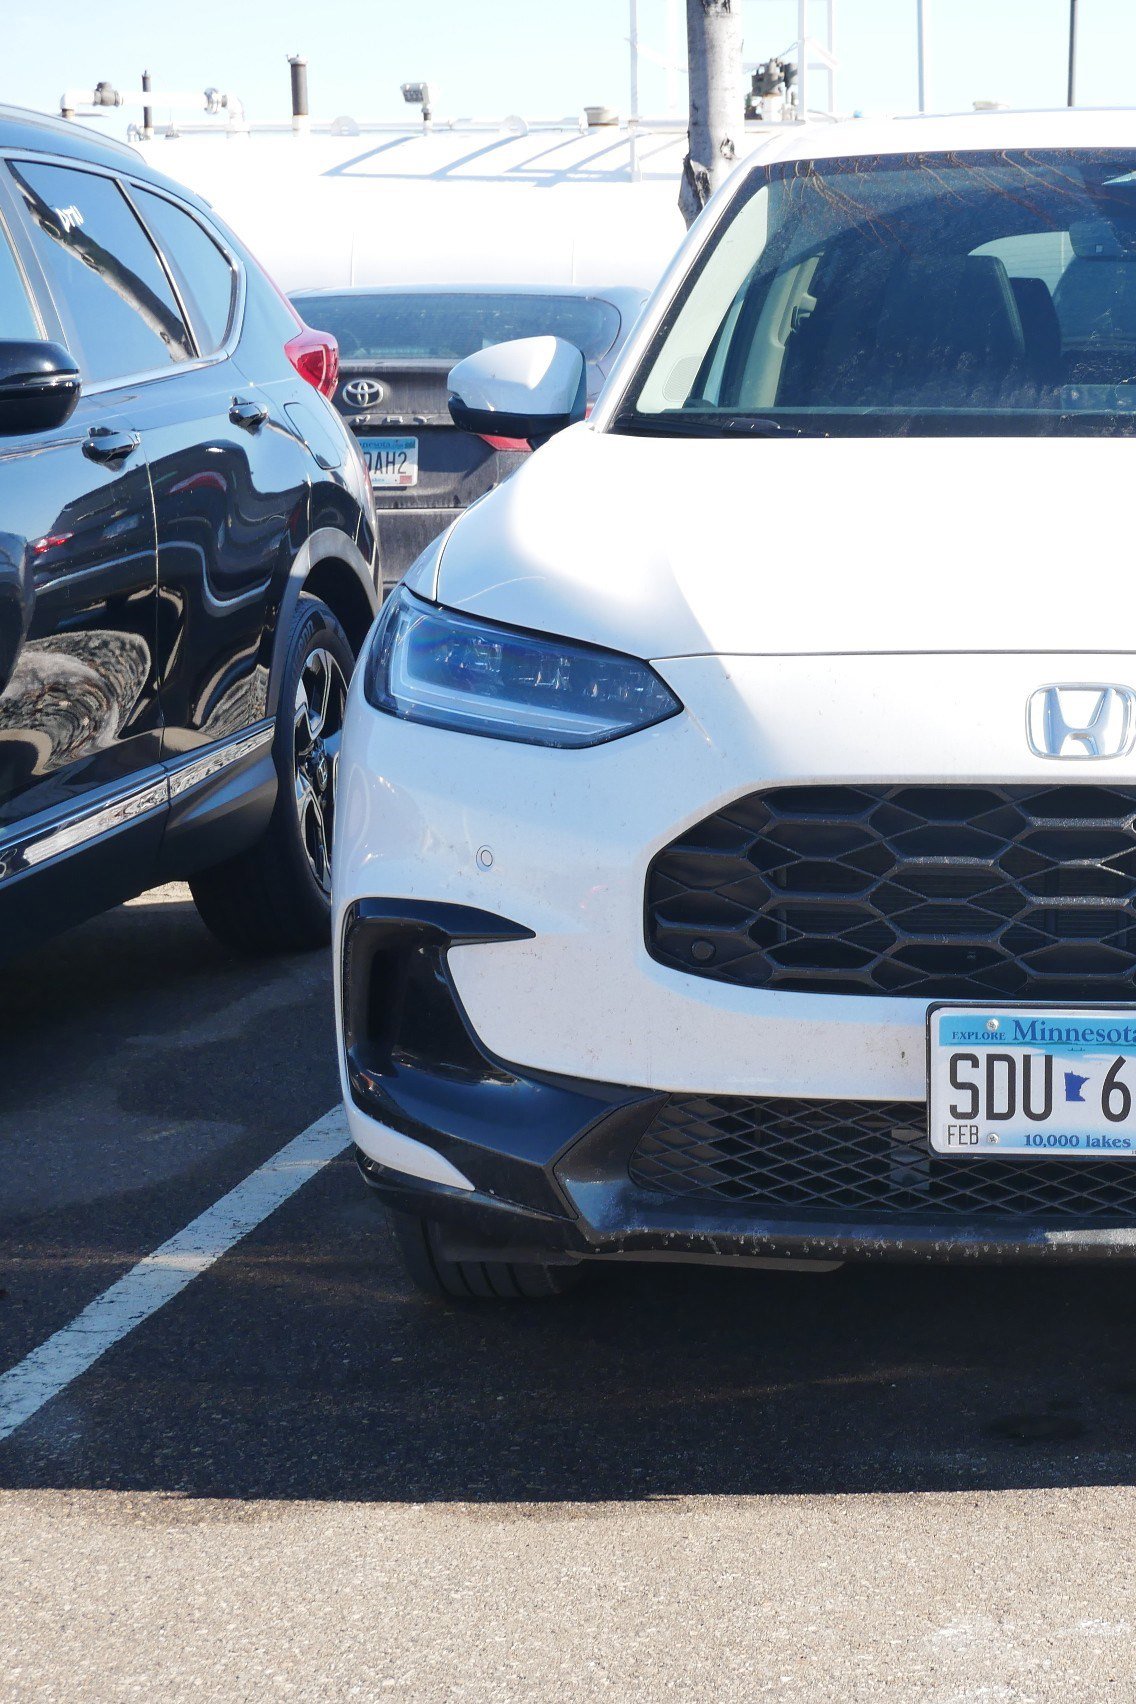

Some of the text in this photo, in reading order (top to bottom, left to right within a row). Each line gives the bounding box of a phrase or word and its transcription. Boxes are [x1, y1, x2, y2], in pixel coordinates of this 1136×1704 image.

[952, 1031, 1006, 1041] EXPLORE
[949, 1053, 1053, 1121] SDU
[947, 1124, 979, 1146] FEB
[1024, 1134, 1132, 1148] 10,000 lakes
